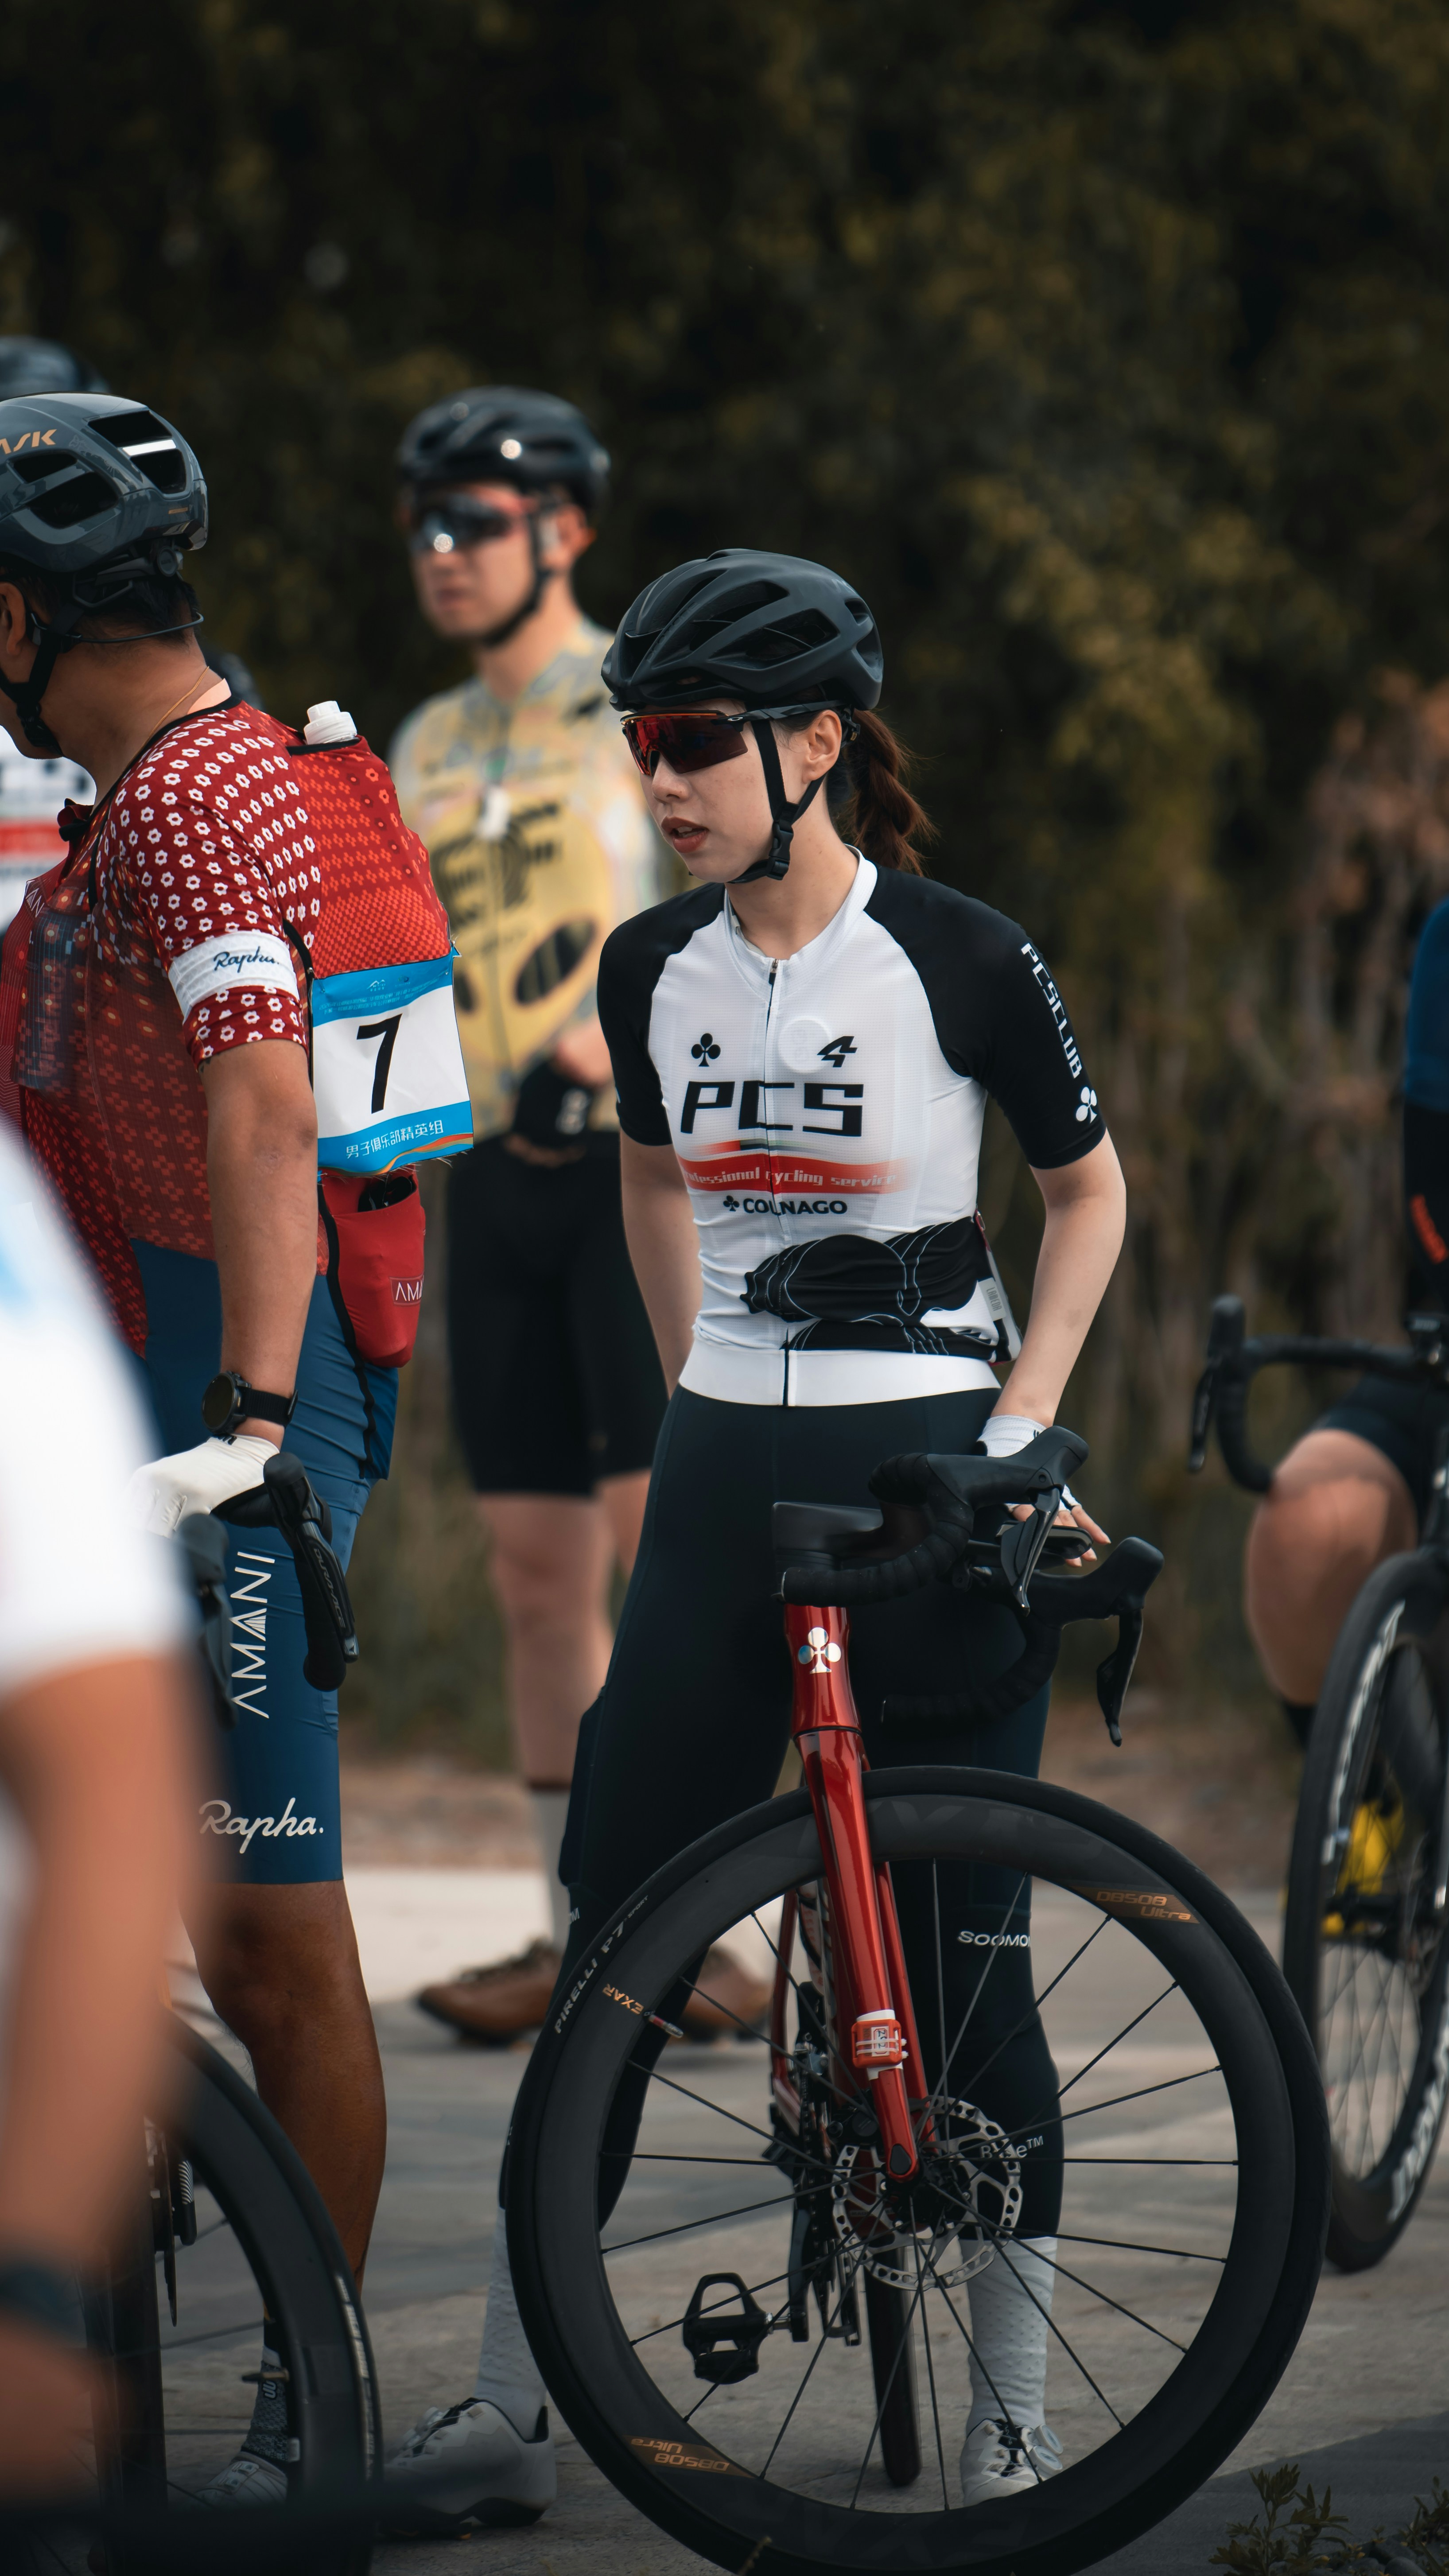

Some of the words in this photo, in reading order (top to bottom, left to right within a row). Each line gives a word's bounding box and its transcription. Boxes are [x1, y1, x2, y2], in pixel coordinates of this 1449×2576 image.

[356, 1014, 403, 1114] 7
[680, 1080, 864, 1138] PCS
[683, 1166, 760, 1185] rofessional
[765, 1169, 823, 1186] cycling
[831, 1175, 897, 1187] service
[743, 1197, 848, 1216] COLNAGO
[229, 1550, 275, 1719] AMANI
[198, 1797, 324, 1854] Rapha.
[1140, 1906, 1192, 1920] Ultra
[554, 1958, 598, 2034] PIRELLI
[602, 1983, 645, 2015] EXAR
[631, 2438, 683, 2454] Ultra
[654, 2452, 730, 2471] DB508
